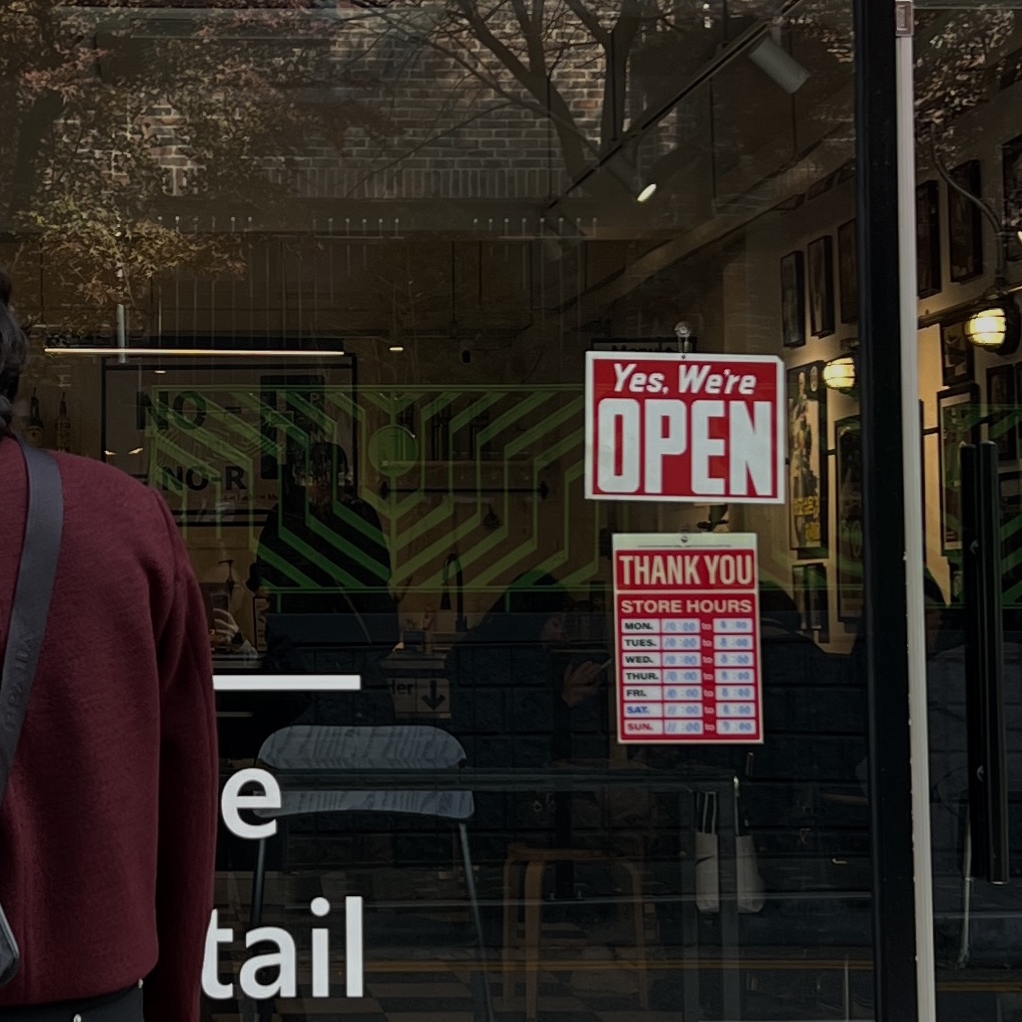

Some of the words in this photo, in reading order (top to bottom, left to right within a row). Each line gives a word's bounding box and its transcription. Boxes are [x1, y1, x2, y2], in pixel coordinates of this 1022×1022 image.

[678, 364, 756, 395] We're
[597, 398, 773, 496] OPEN
[619, 555, 700, 585] THANK
[704, 555, 753, 585] YOU
[621, 600, 682, 613] STORE
[686, 600, 752, 613] HOURS
[624, 622, 653, 630] MON.
[625, 639, 657, 647] TUES.
[702, 639, 712, 647] to
[702, 656, 713, 664] to
[626, 672, 658, 680] THUR.
[704, 690, 714, 698] to
[627, 706, 649, 714] SAT.
[704, 706, 714, 714] to
[628, 723, 653, 731] SUN.
[705, 723, 715, 731] to
